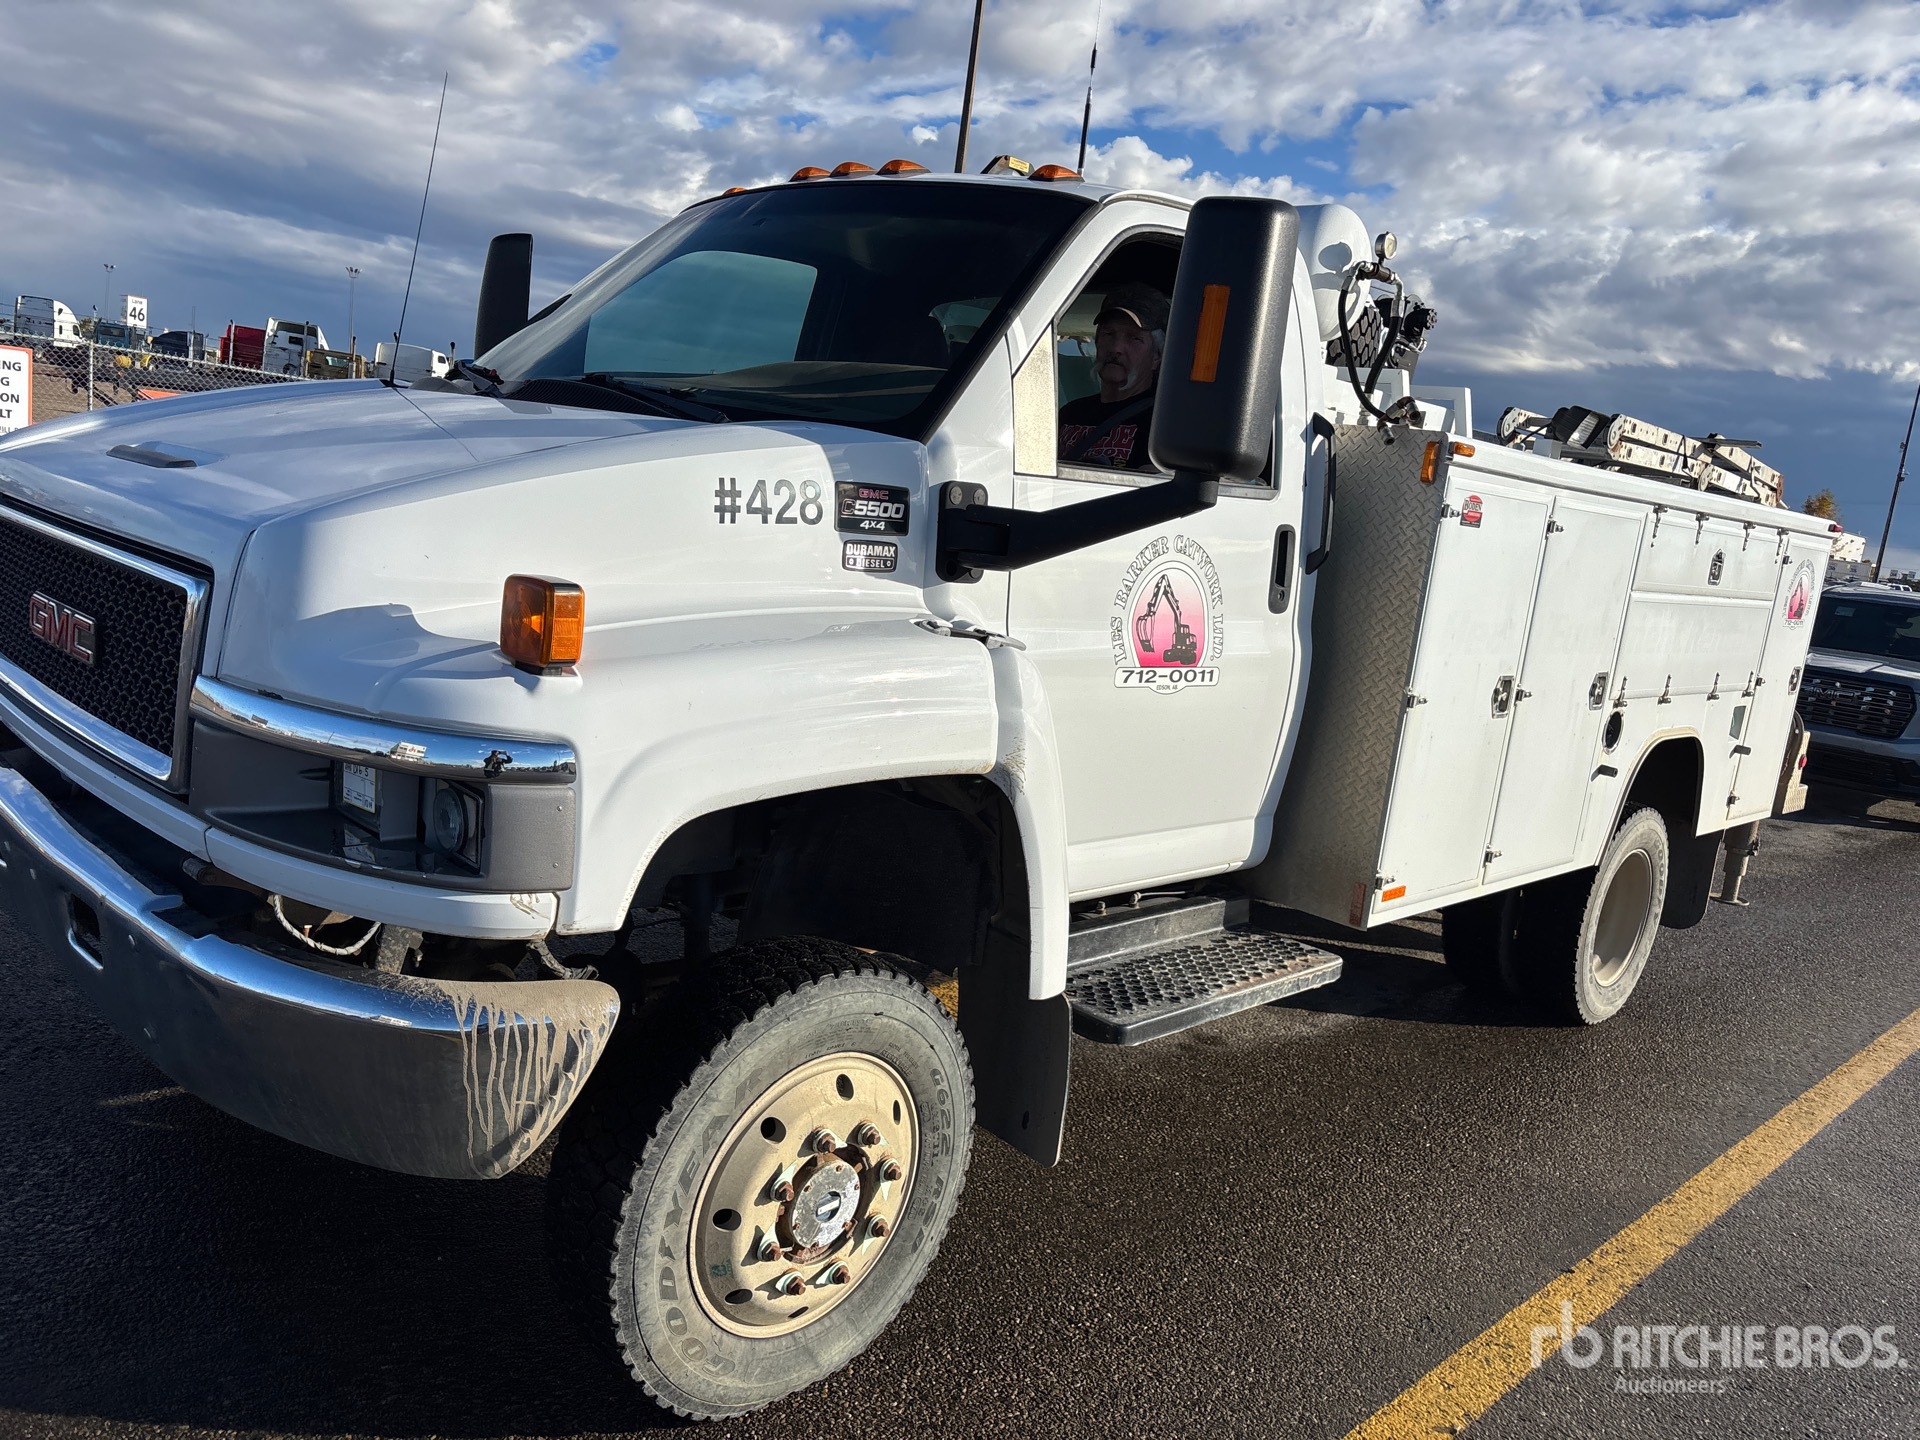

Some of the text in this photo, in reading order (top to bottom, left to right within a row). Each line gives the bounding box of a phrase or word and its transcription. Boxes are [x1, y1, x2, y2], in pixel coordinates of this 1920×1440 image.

[129, 306, 145, 322] 46
[0, 360, 22, 372] NG
[0, 376, 10, 387] G
[0, 408, 13, 419] LT
[714, 477, 824, 526] #428
[859, 488, 889, 500] GMC
[841, 498, 905, 519] C5500
[846, 543, 896, 558] DURAMAX
[855, 557, 885, 568] DIESEL
[1173, 534, 1223, 609] CATWORK
[1114, 535, 1169, 610] BARKER
[29, 592, 95, 665] GMC
[1111, 616, 1127, 665] LES
[1122, 669, 1215, 684] 712-0011
[929, 1068, 952, 1157] G622
[658, 1067, 764, 1378] GOODYEAR
